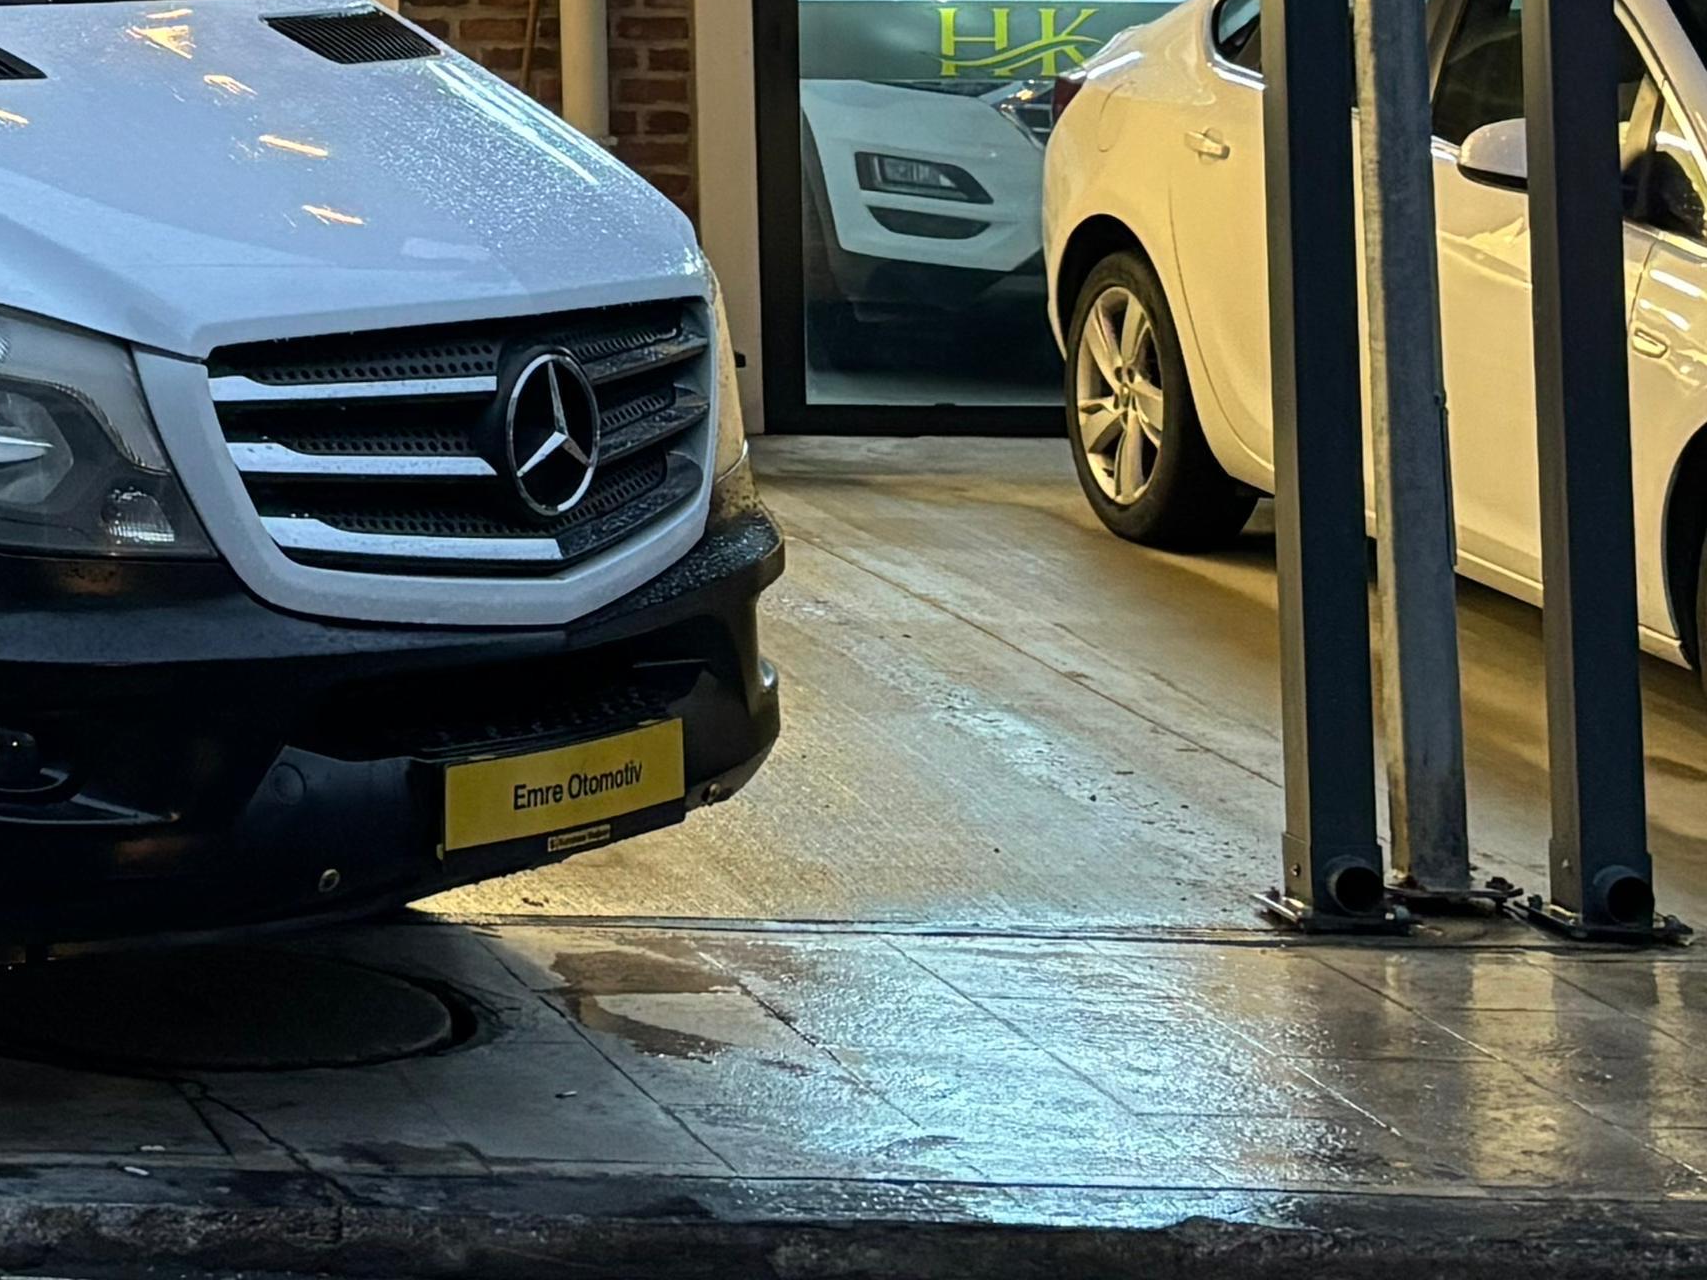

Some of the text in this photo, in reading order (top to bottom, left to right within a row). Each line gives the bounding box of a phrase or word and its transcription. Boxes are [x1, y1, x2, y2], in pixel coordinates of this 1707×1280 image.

[938, 7, 1100, 76] HK
[513, 760, 643, 810] Emre Otomotiv
